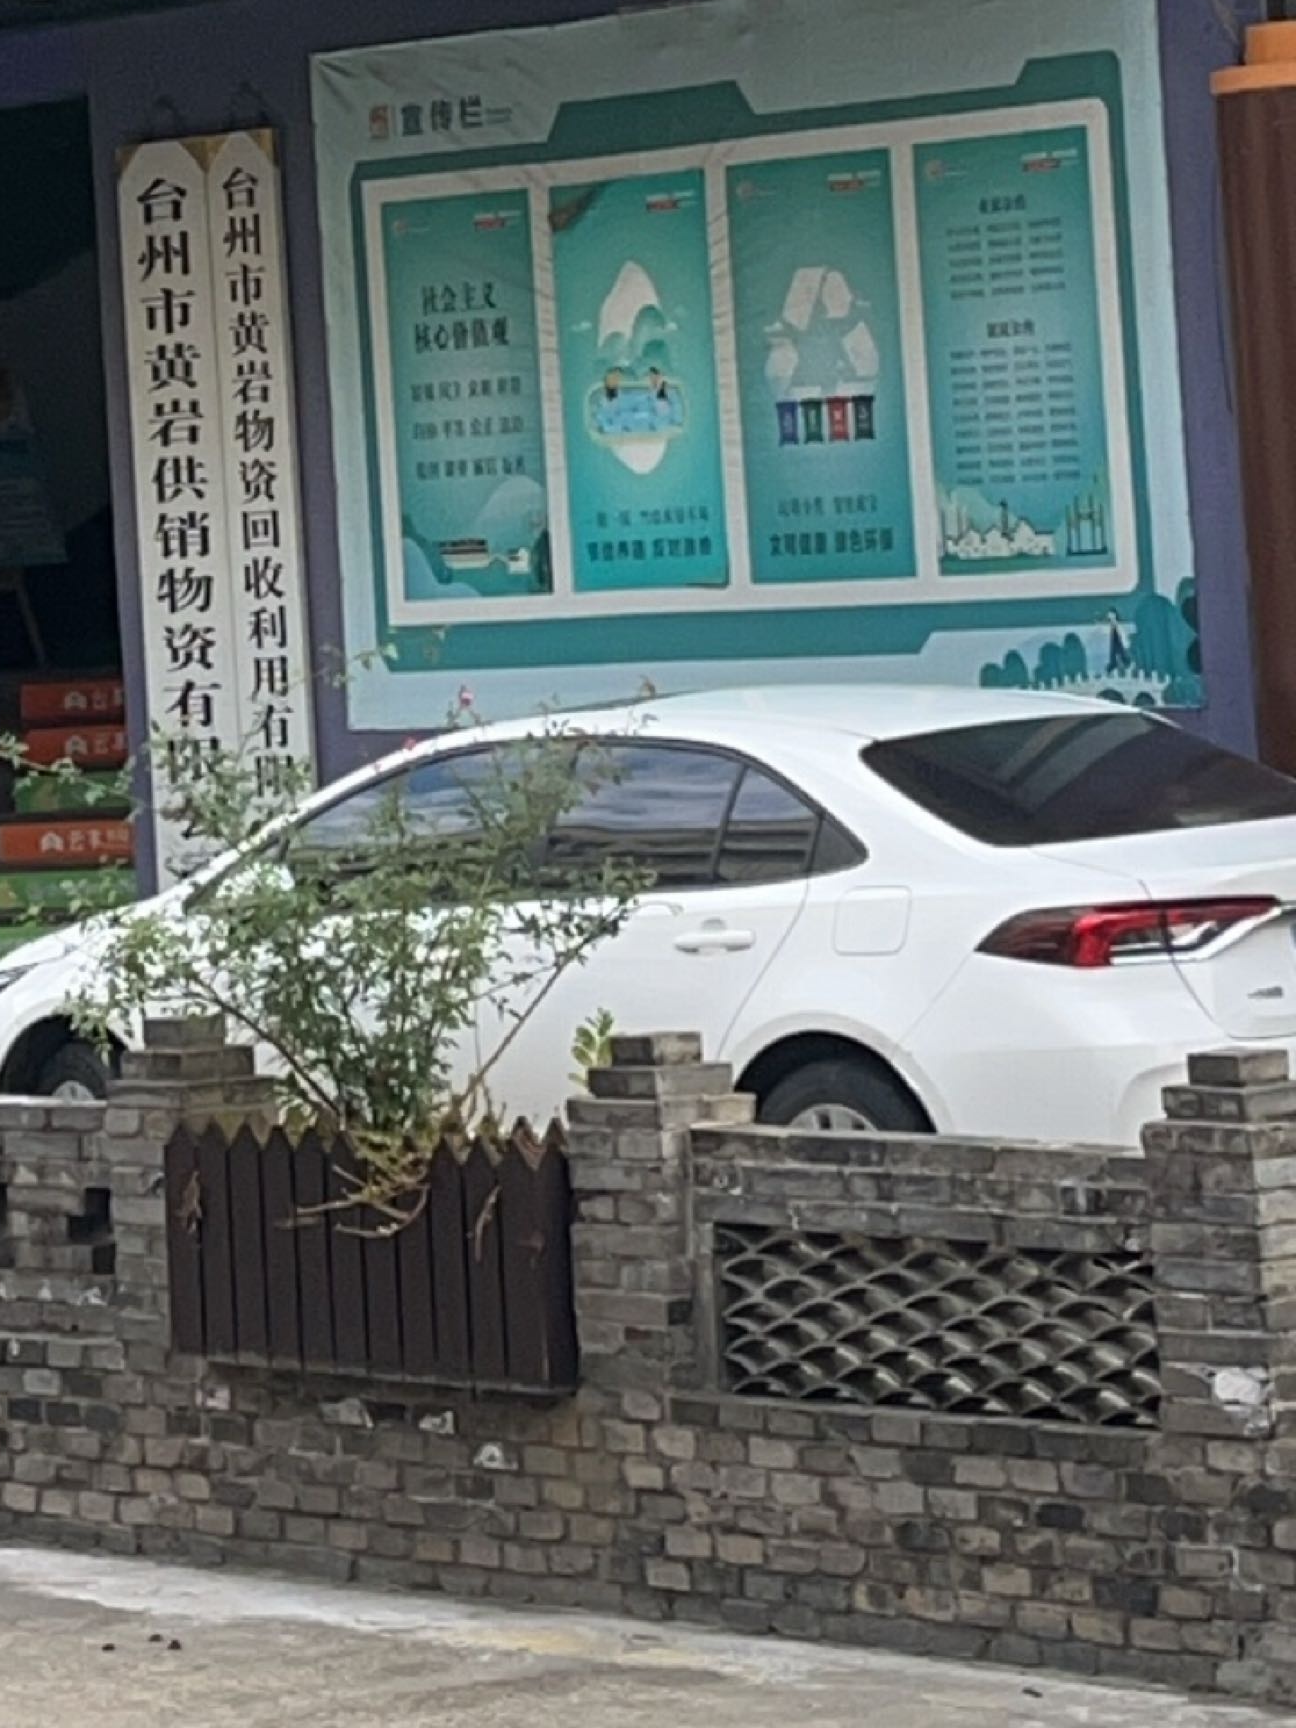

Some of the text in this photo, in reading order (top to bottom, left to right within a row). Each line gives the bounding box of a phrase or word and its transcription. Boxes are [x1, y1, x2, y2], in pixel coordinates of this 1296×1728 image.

[401, 95, 483, 137] 宣传栏
[422, 281, 497, 316] 社会主义
[415, 316, 510, 354] 核心价值观
